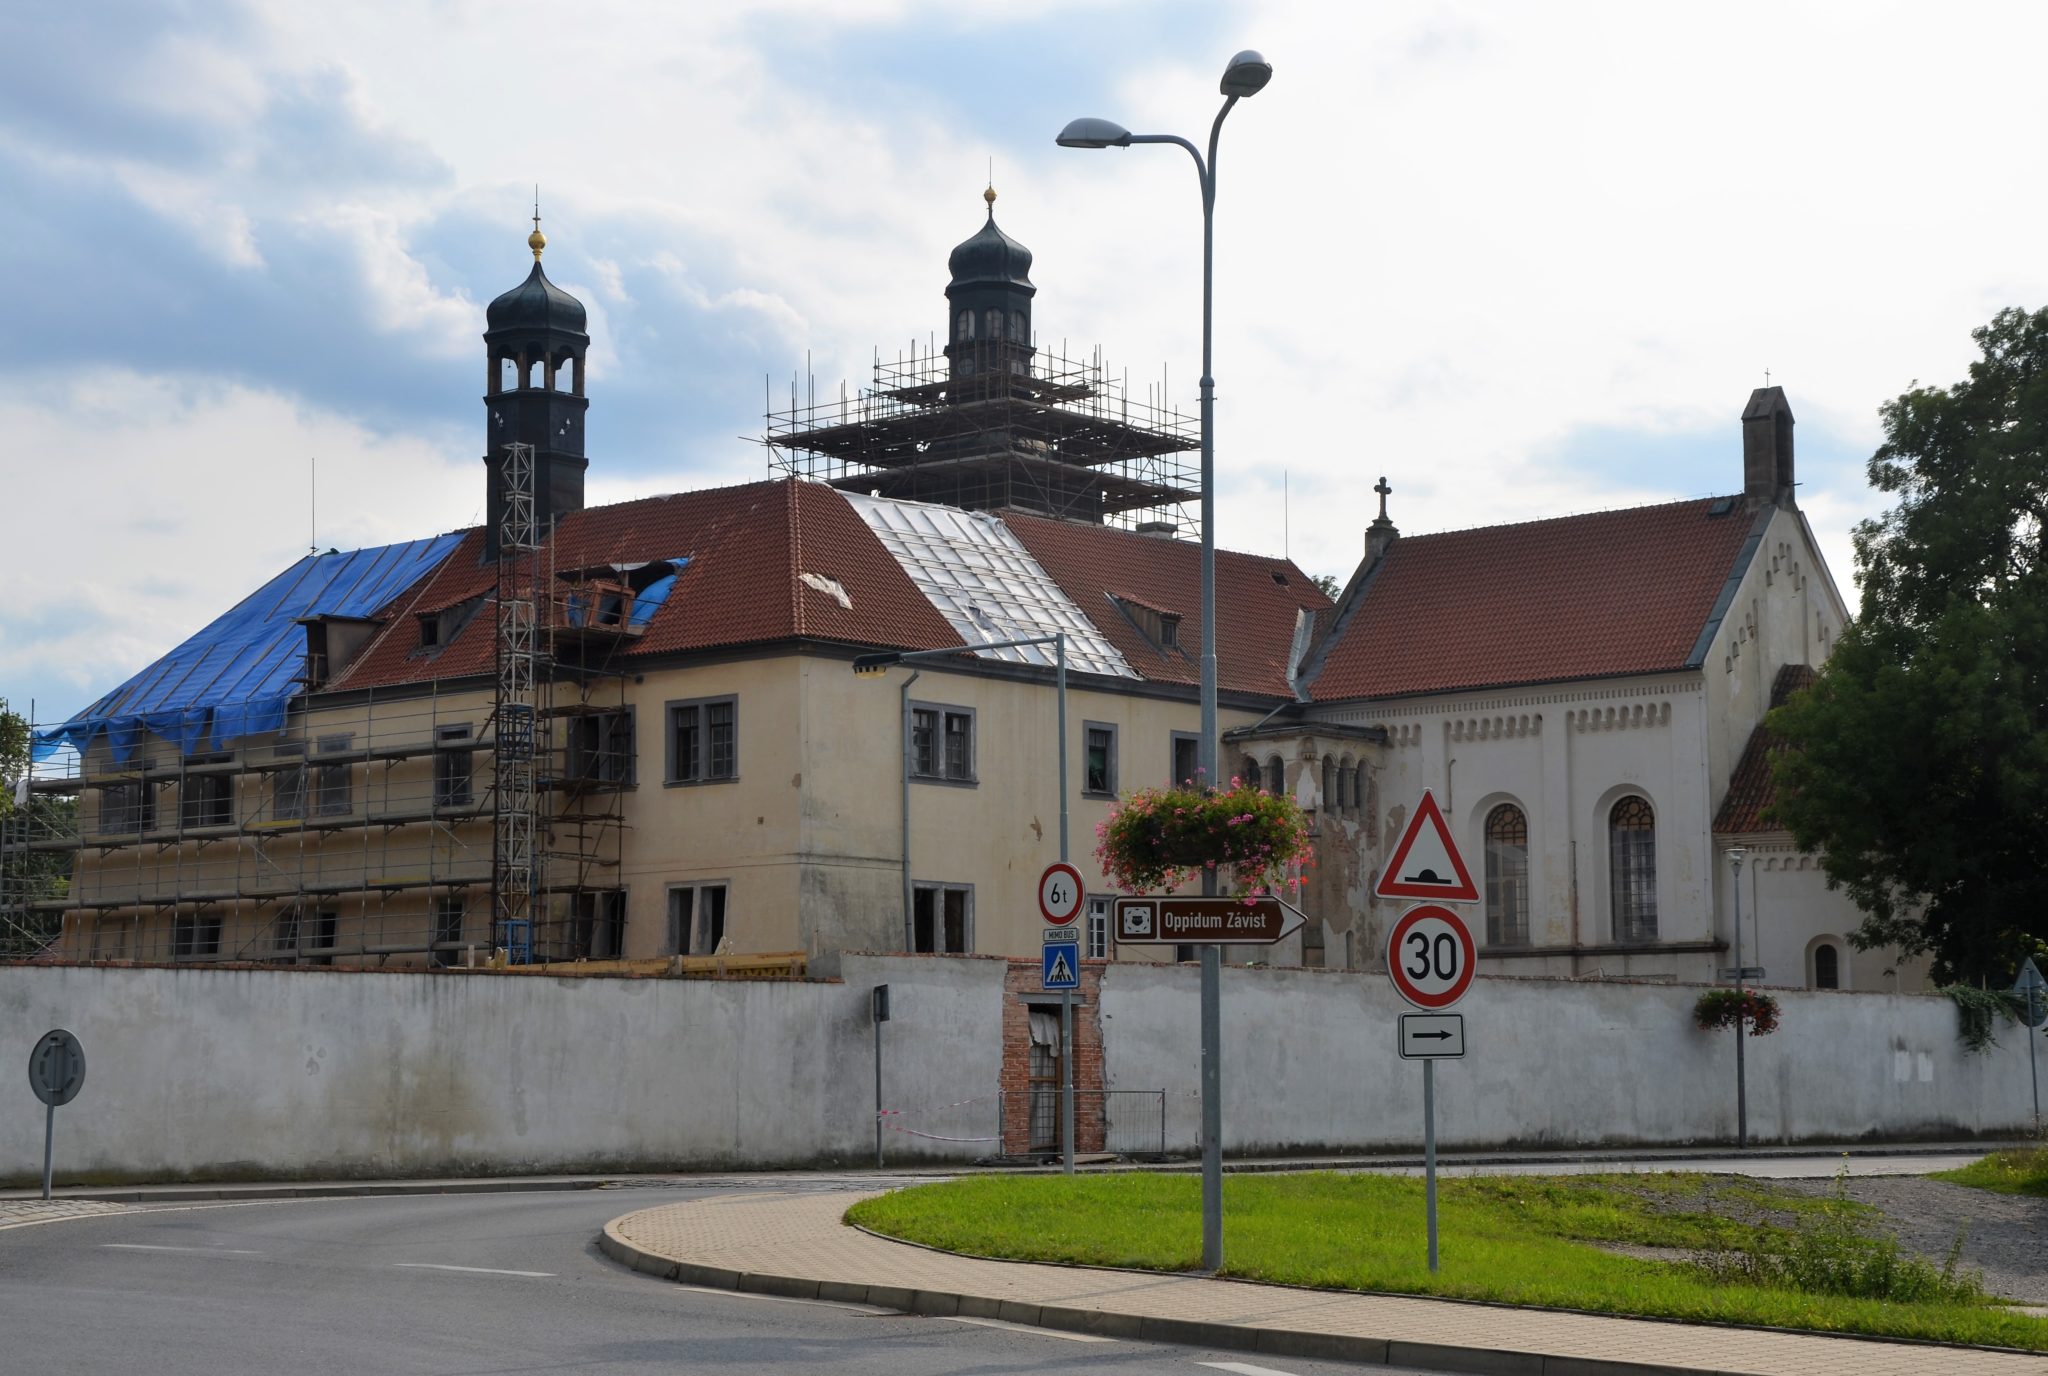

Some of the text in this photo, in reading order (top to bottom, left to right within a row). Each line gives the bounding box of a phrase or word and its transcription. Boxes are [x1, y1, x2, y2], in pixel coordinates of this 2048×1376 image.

[1051, 883, 1067, 904] 6 t
[1165, 911, 1266, 932] Oppidum Závist
[1048, 930, 1074, 939] MIMO BUS
[1406, 931, 1457, 980] 30
